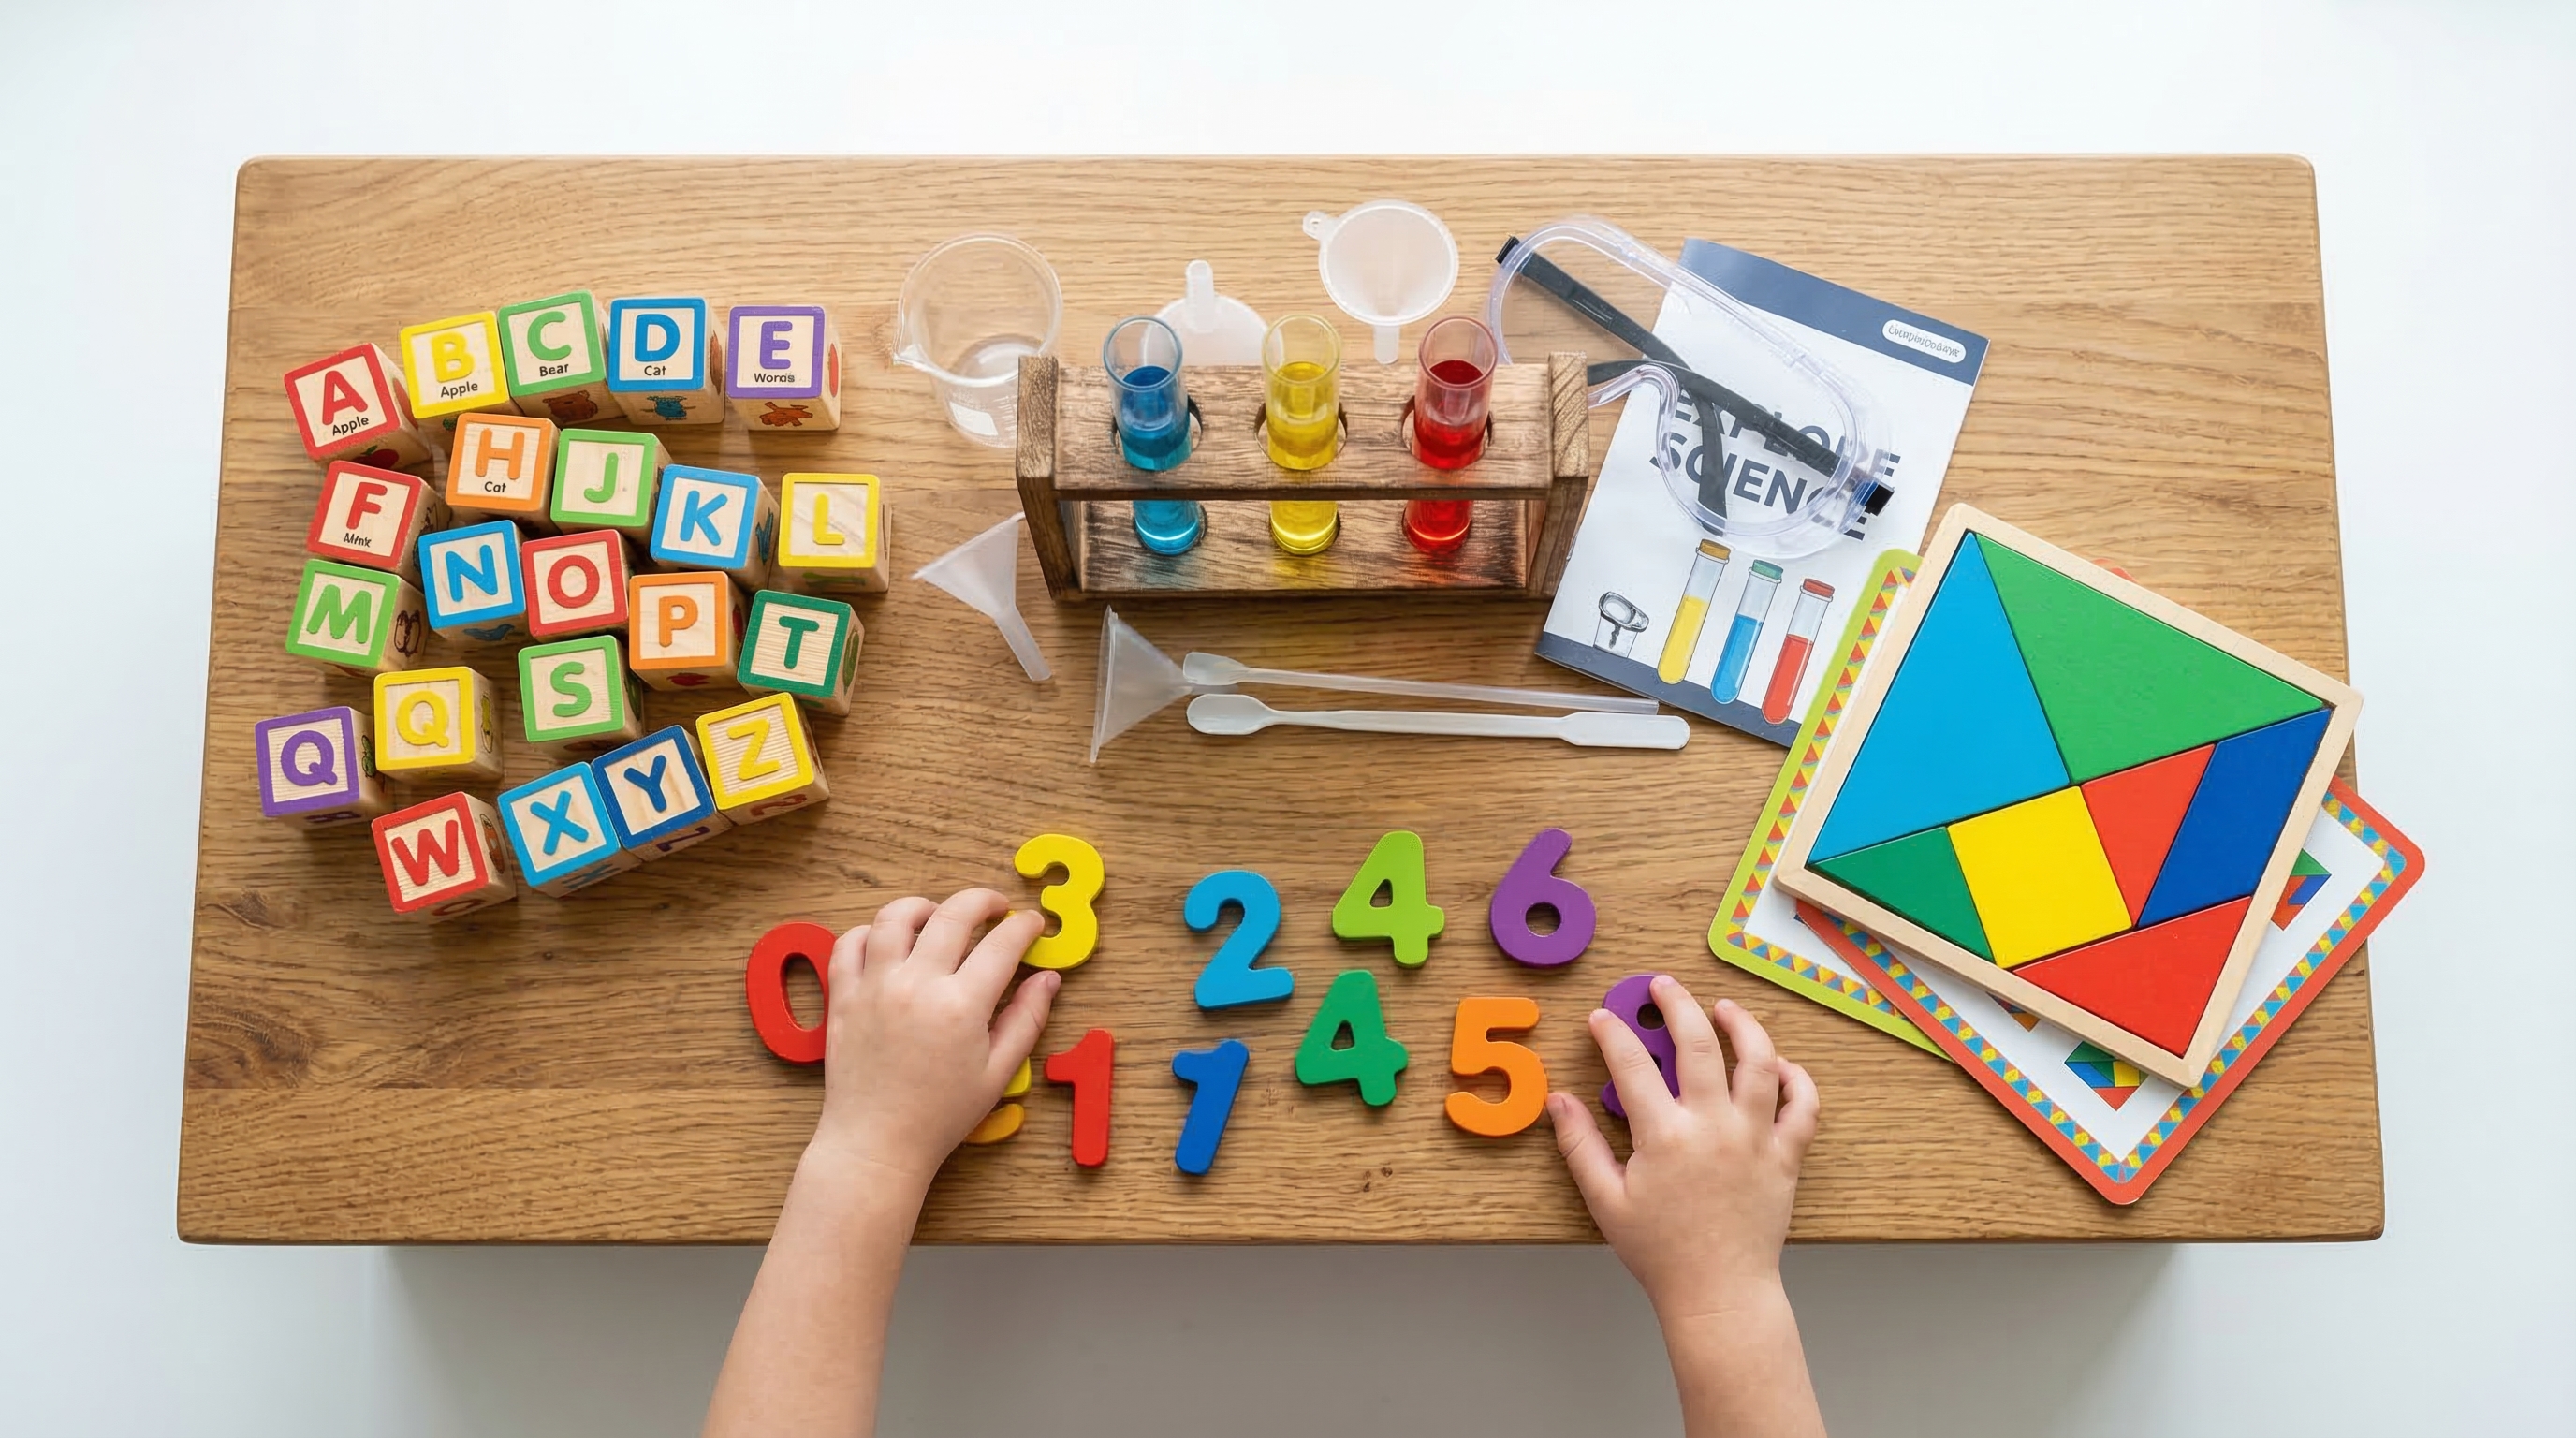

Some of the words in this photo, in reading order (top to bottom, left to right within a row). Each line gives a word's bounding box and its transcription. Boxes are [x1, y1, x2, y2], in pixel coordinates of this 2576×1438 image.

[431, 332, 475, 383] B
[527, 311, 572, 361] C
[634, 314, 681, 362] D
[759, 320, 793, 370] E
[440, 381, 478, 398] Apple
[538, 361, 569, 377] Bear
[643, 365, 666, 377] Cat
[322, 370, 368, 426] A
[331, 416, 370, 436] Apple
[475, 428, 525, 480] H
[1672, 388, 1901, 477] EXOE
[346, 481, 388, 530] F
[484, 480, 507, 493] Cat
[583, 452, 619, 503] J
[680, 490, 728, 546] K
[812, 492, 845, 545] L
[445, 544, 498, 603] N
[547, 554, 601, 609] O
[306, 584, 373, 644] M
[658, 595, 699, 648] P
[778, 615, 820, 669] T
[549, 661, 593, 717] S
[395, 690, 449, 748] Q
[281, 729, 338, 787] Q
[726, 717, 781, 781] Z
[623, 754, 667, 813] Y
[530, 790, 590, 856] X
[390, 819, 461, 887] W
[1014, 833, 1105, 969] 3
[1331, 829, 1445, 968] 4
[1488, 827, 1596, 967] 6
[1183, 869, 1295, 1010] 2
[746, 921, 836, 1065] 0
[1295, 969, 1409, 1107] 4
[1444, 996, 1548, 1137] 5
[1045, 1028, 1115, 1167] 1
[1172, 1039, 1250, 1175] 1
